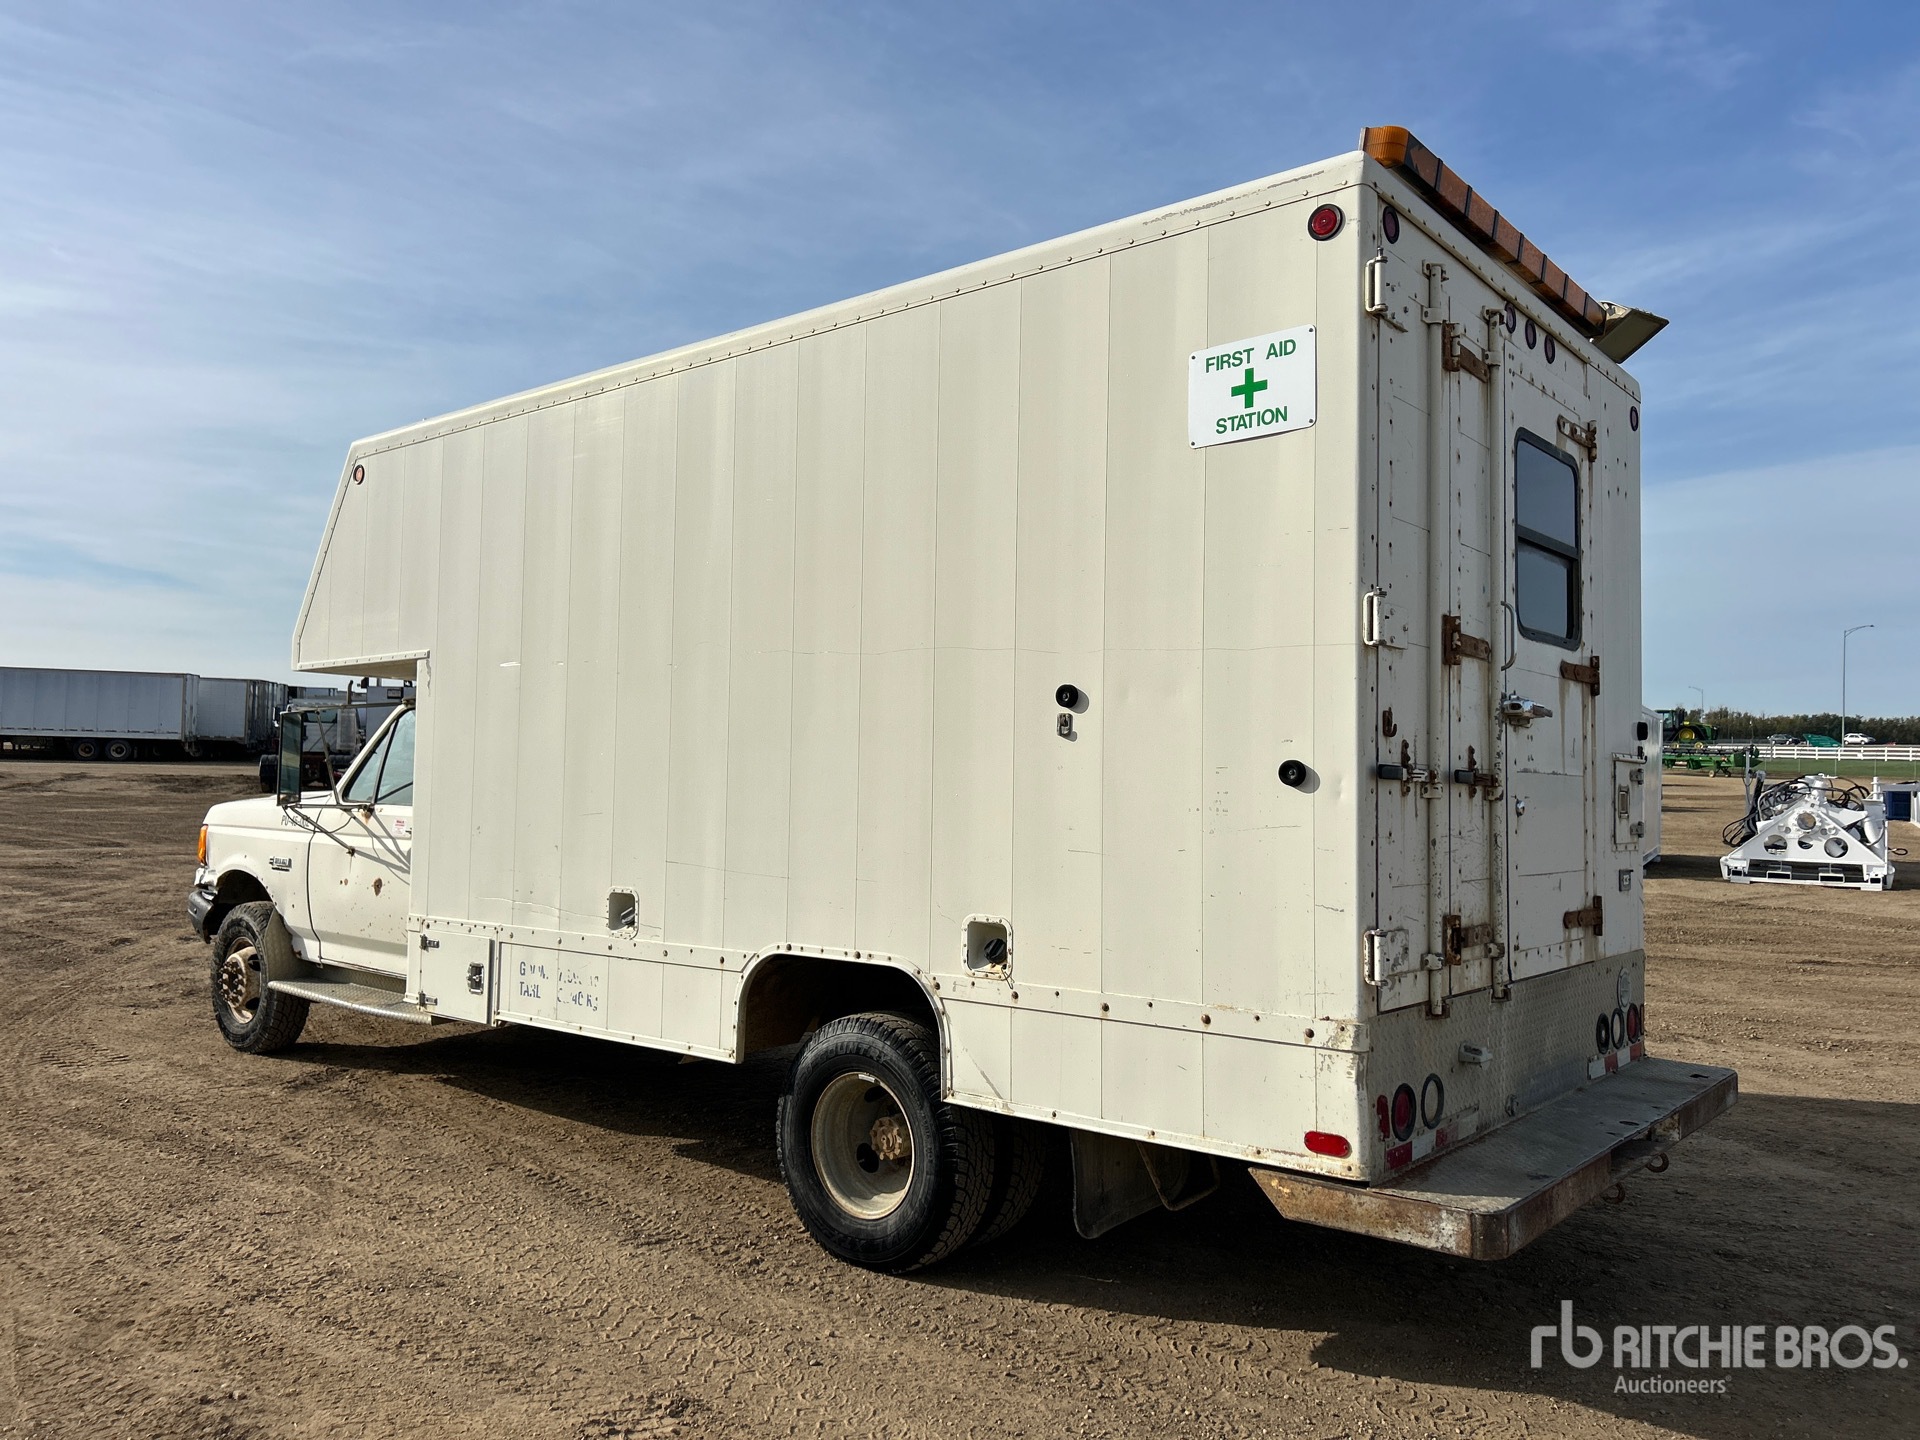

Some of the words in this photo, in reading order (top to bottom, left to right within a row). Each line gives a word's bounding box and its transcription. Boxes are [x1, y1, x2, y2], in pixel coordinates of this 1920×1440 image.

[1205, 347, 1255, 373] FIRST
[1266, 339, 1297, 360] AID
[1215, 406, 1288, 434] STATION
